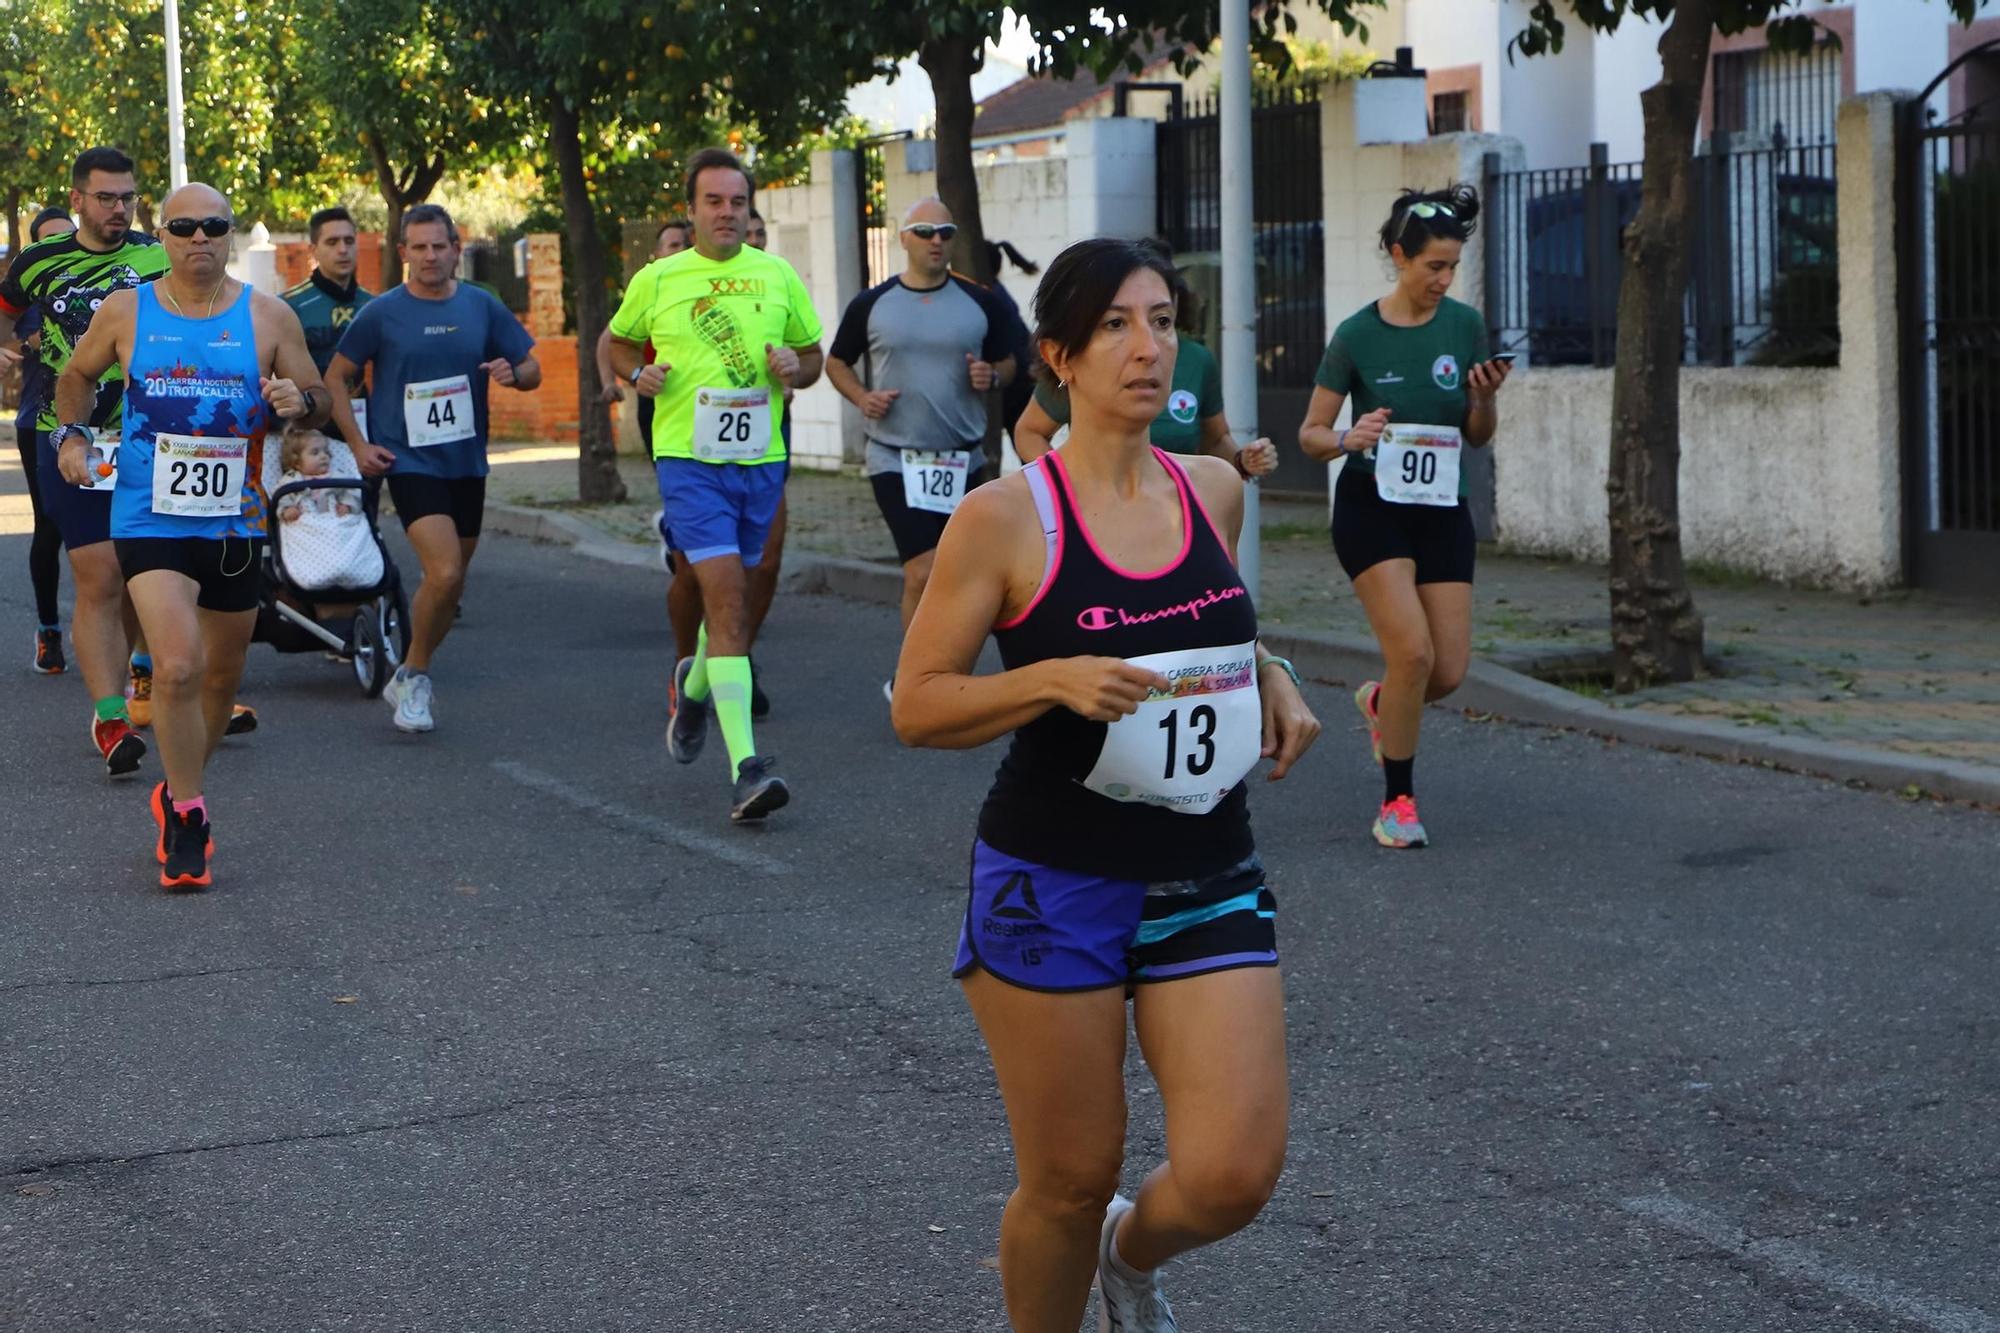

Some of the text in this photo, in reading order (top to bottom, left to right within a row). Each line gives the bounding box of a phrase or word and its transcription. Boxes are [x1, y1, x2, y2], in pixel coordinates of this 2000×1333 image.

[424, 325, 446, 335] RUN
[145, 377, 167, 398] 20
[166, 376, 244, 389] CARRERA NOCTURNA
[167, 385, 244, 400] TROTACALLES
[427, 398, 456, 428] 44
[718, 411, 751, 443] 26
[169, 460, 228, 497] 230
[1401, 450, 1436, 484] 90
[917, 469, 955, 497] 128
[1076, 584, 1245, 630] Champion
[1167, 665, 1215, 681] CARRERA
[1215, 657, 1254, 675] POPULAR
[1188, 679, 1211, 693] REAL
[1158, 704, 1217, 780] 13
